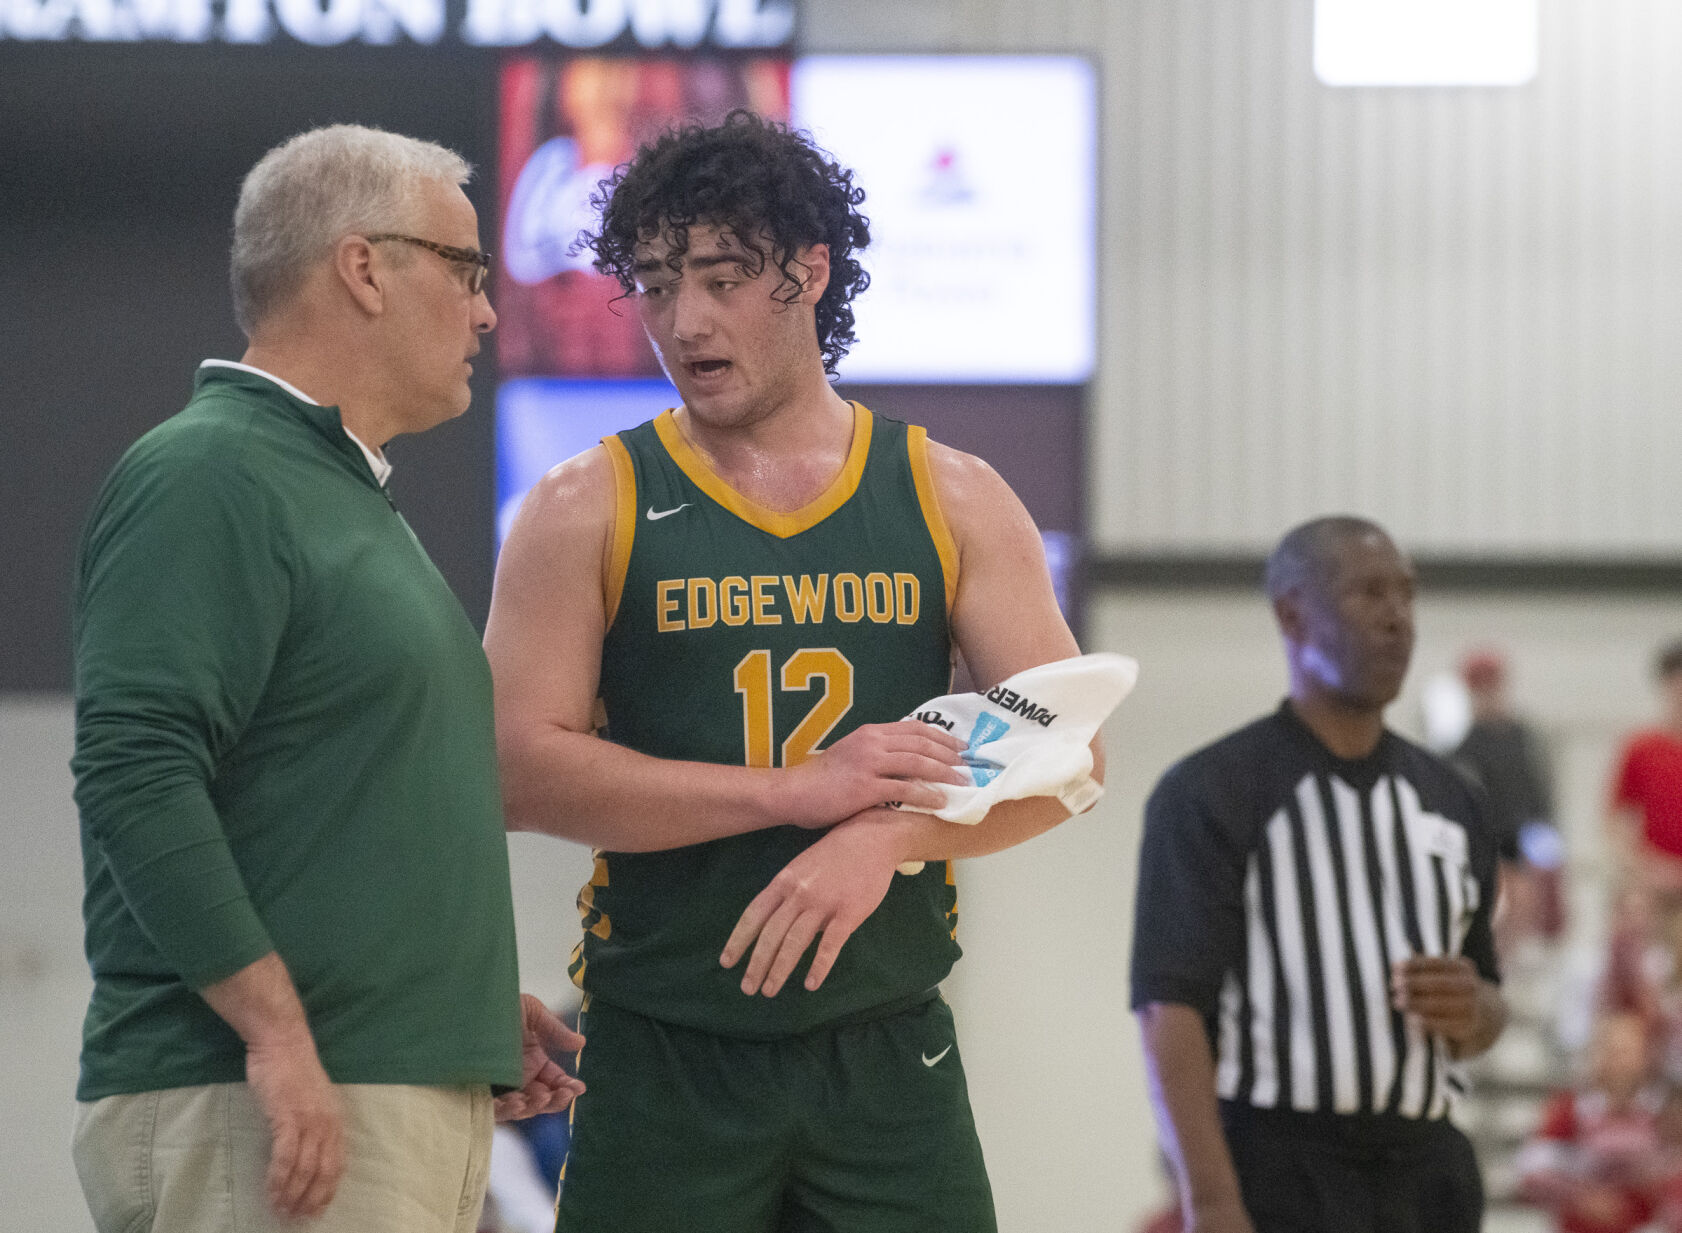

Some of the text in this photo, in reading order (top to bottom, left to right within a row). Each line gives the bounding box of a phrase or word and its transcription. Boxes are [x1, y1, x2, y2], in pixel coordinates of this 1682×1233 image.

[656, 572, 920, 633] EDGEWOOD
[733, 647, 854, 768] 12
[980, 684, 1058, 728] POWER
